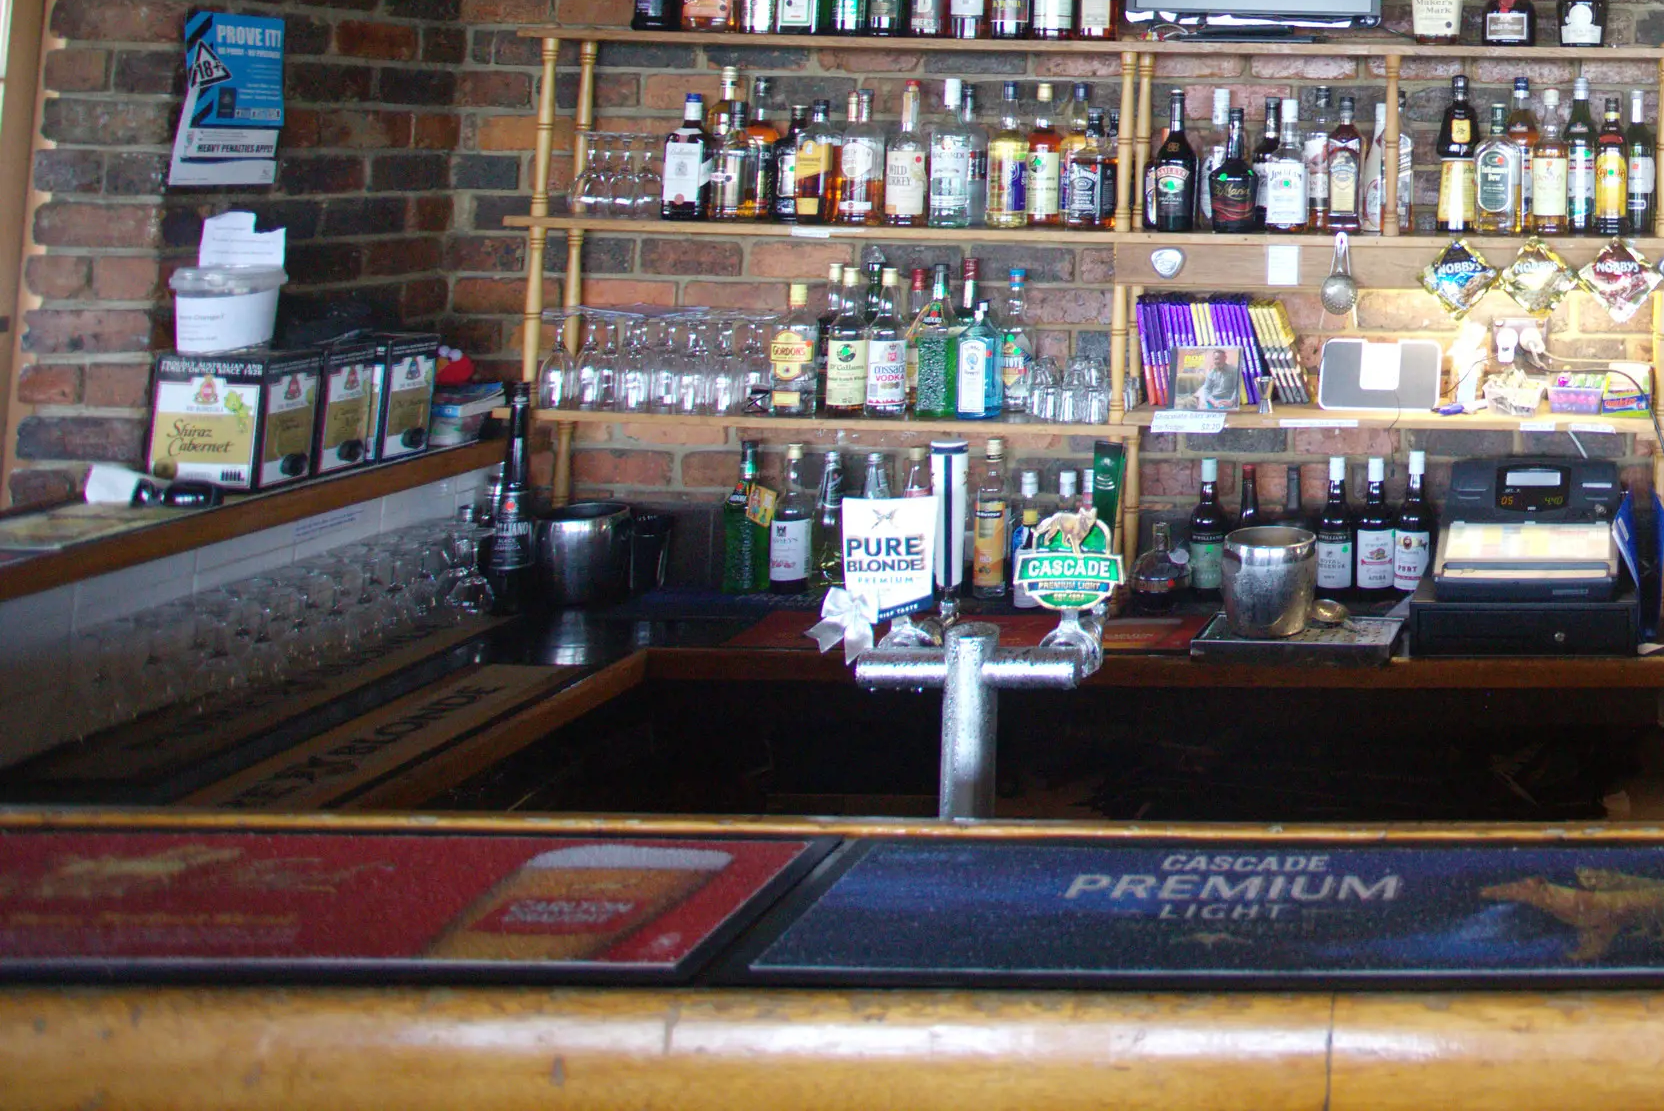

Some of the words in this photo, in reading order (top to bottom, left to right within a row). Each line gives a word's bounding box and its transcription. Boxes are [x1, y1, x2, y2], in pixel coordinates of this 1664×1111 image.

[1426, 6, 1452, 14] Mark
[216, 24, 263, 47] PROVE
[197, 60, 223, 80] 18+
[166, 418, 213, 438] Shiraz
[168, 437, 235, 457] Cabernet
[846, 537, 921, 557] PURE
[846, 558, 923, 573] BLONDE
[1028, 559, 1111, 578] CASCADE
[857, 576, 914, 584] PREMIUM
[1038, 581, 1076, 590] PREMIUM
[1077, 582, 1101, 591] LIGHT
[1161, 855, 1331, 872] CASCADE
[1063, 874, 1404, 901] PREMIUM
[1158, 903, 1291, 920] LIGHT
